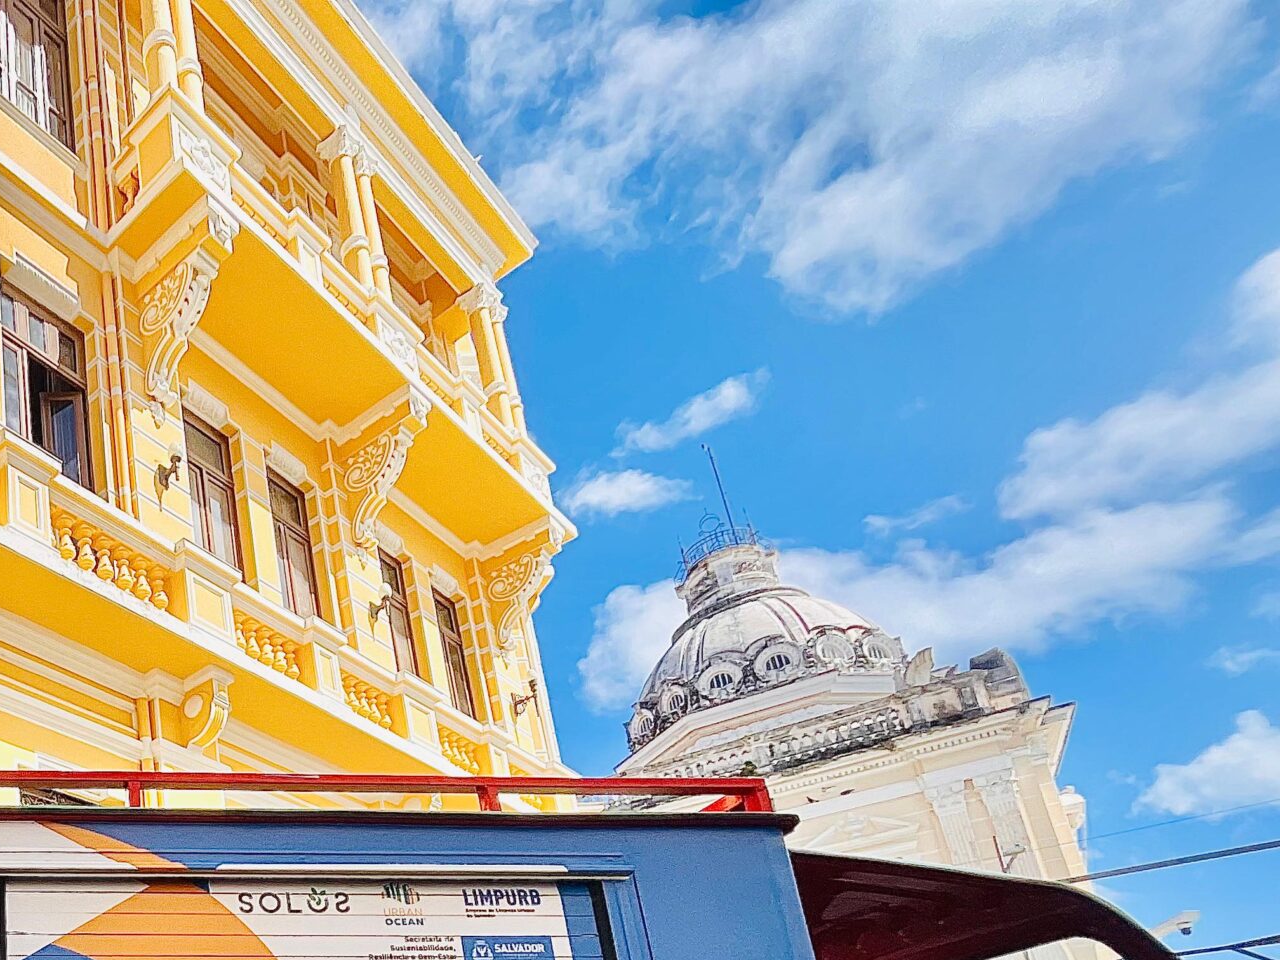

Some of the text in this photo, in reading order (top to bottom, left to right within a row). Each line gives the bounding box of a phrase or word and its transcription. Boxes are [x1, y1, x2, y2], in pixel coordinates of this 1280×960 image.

[461, 888, 542, 907] LIMPURB
[383, 908, 423, 916] URBAN
[385, 918, 424, 926] OCEAN
[494, 943, 546, 953] SALVADOR
